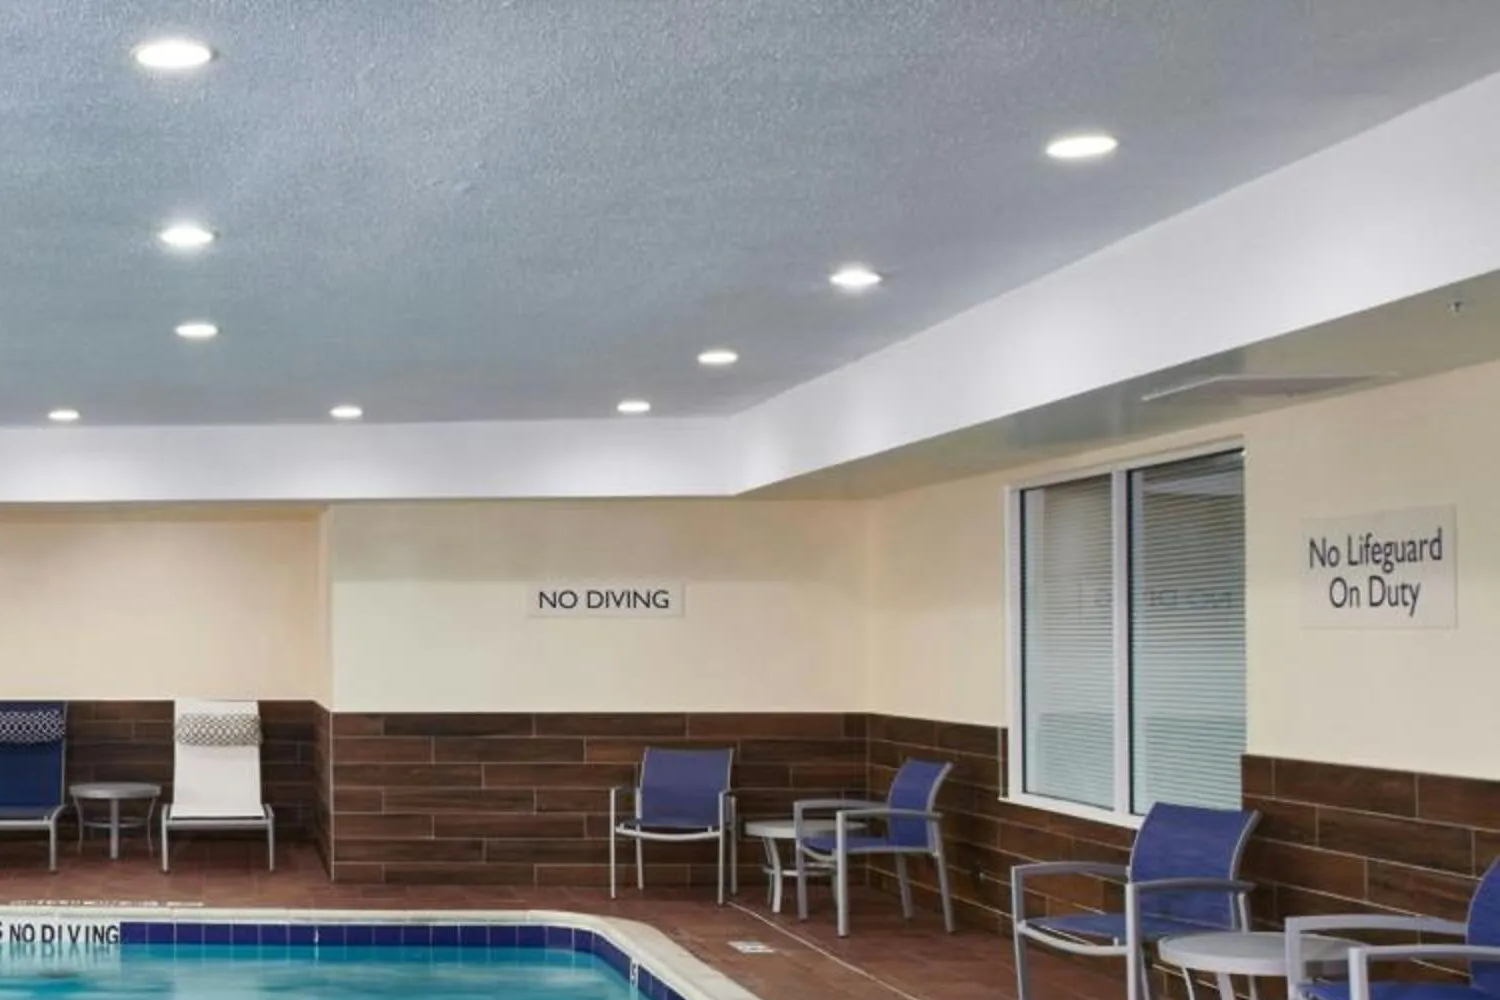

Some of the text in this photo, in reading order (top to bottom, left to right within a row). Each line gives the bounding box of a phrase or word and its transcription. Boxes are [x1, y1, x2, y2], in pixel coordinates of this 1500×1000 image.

[1308, 526, 1444, 575] No Lifeguard
[538, 589, 671, 610] NO DIVING
[1328, 574, 1422, 618] On Duty
[8, 923, 36, 944] NO
[41, 924, 120, 945] DIVING
